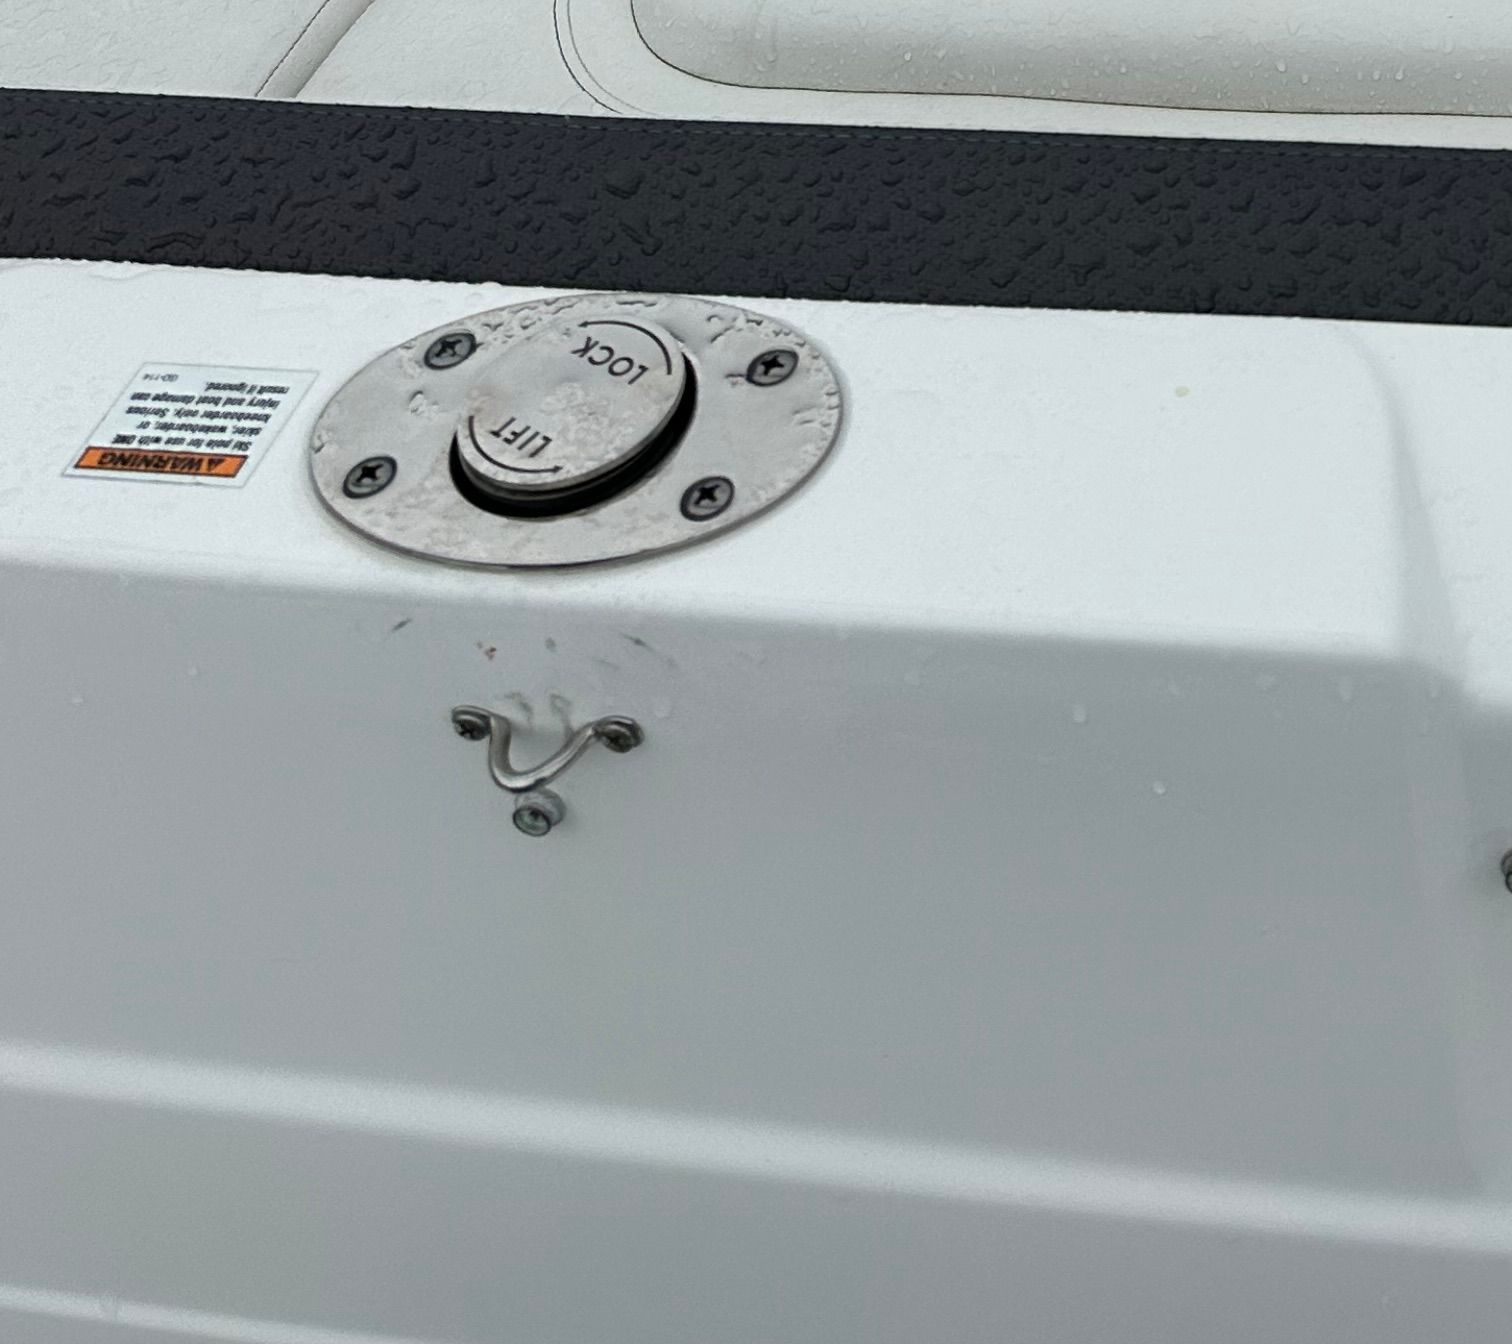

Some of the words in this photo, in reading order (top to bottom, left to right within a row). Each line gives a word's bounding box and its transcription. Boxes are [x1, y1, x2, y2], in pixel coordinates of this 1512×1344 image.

[571, 336, 649, 385] LOCK
[490, 416, 553, 458] LIFT
[97, 452, 204, 472] WARNING
